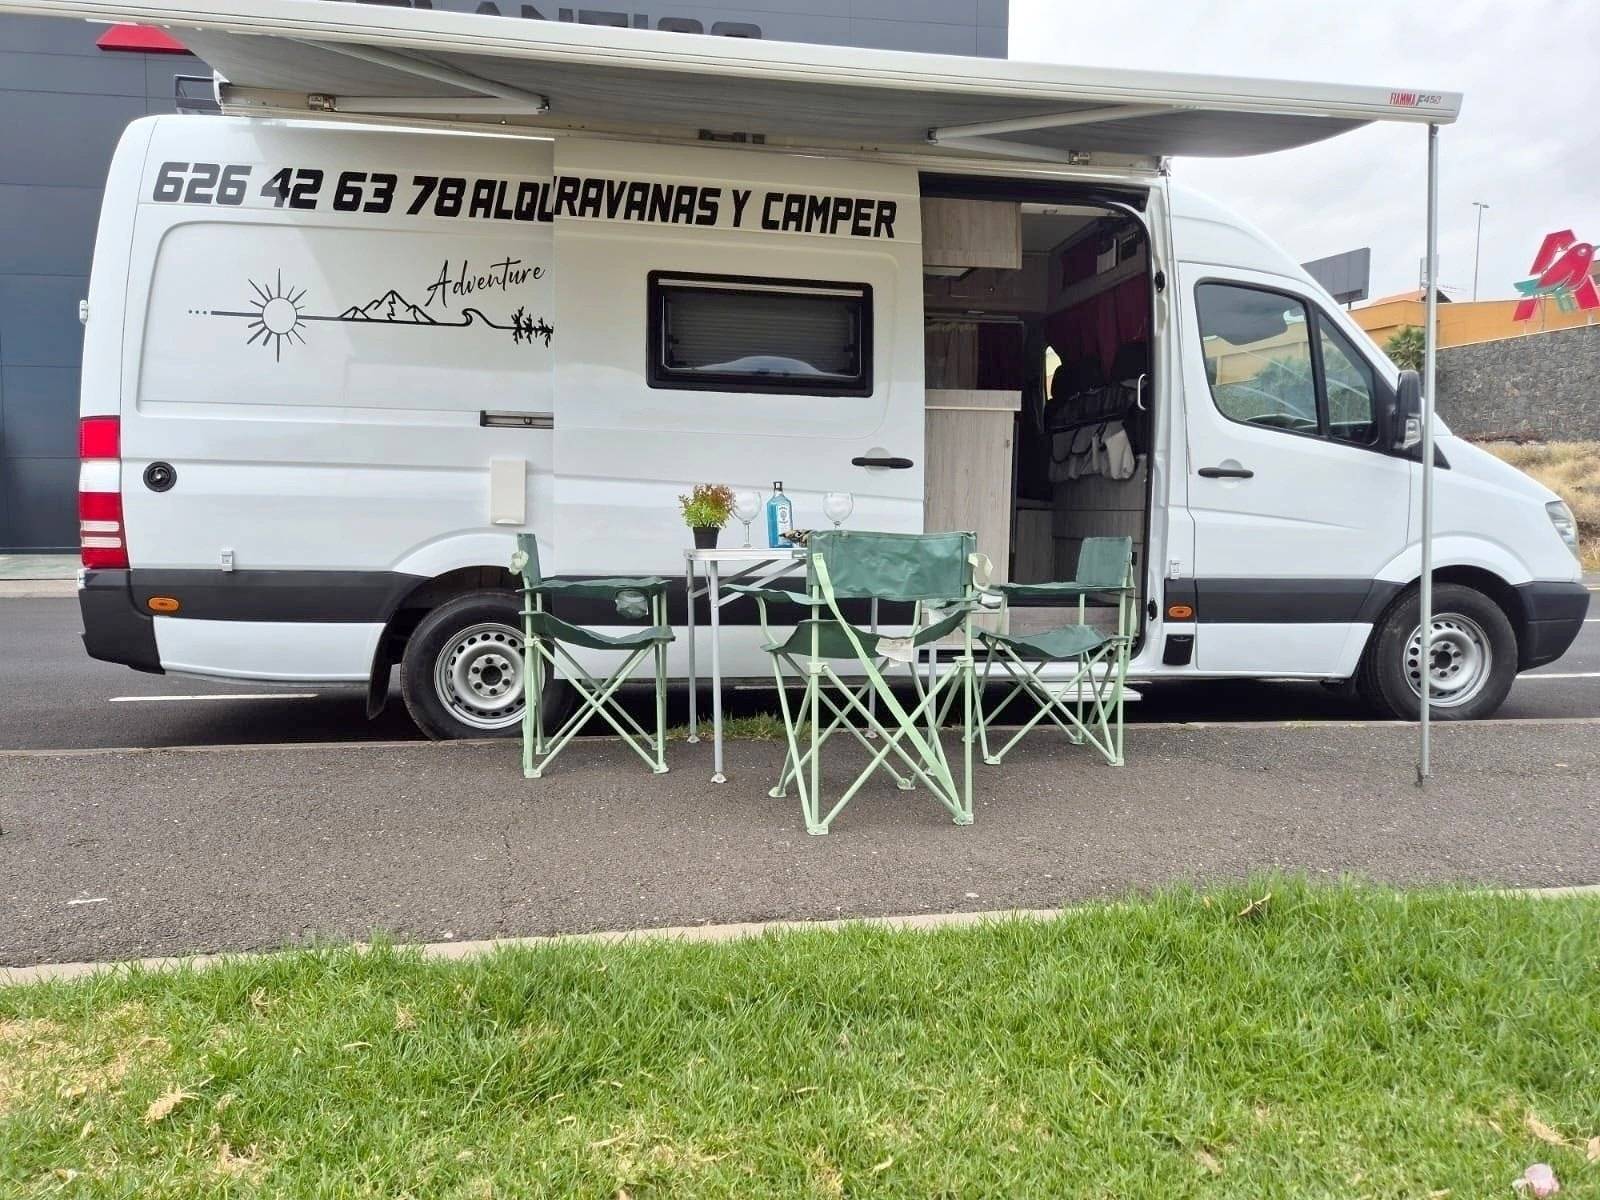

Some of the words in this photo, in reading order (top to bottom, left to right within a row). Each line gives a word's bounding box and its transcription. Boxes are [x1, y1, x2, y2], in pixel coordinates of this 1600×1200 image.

[1389, 92, 1416, 106] FIAMMA
[153, 161, 253, 206] 626
[260, 167, 324, 210] 42
[333, 171, 398, 214] 63
[406, 175, 467, 218] 78
[553, 175, 722, 226] RAVANAS
[732, 189, 752, 228] Y
[761, 191, 897, 239] CAMPER
[424, 256, 546, 308] Adventure
